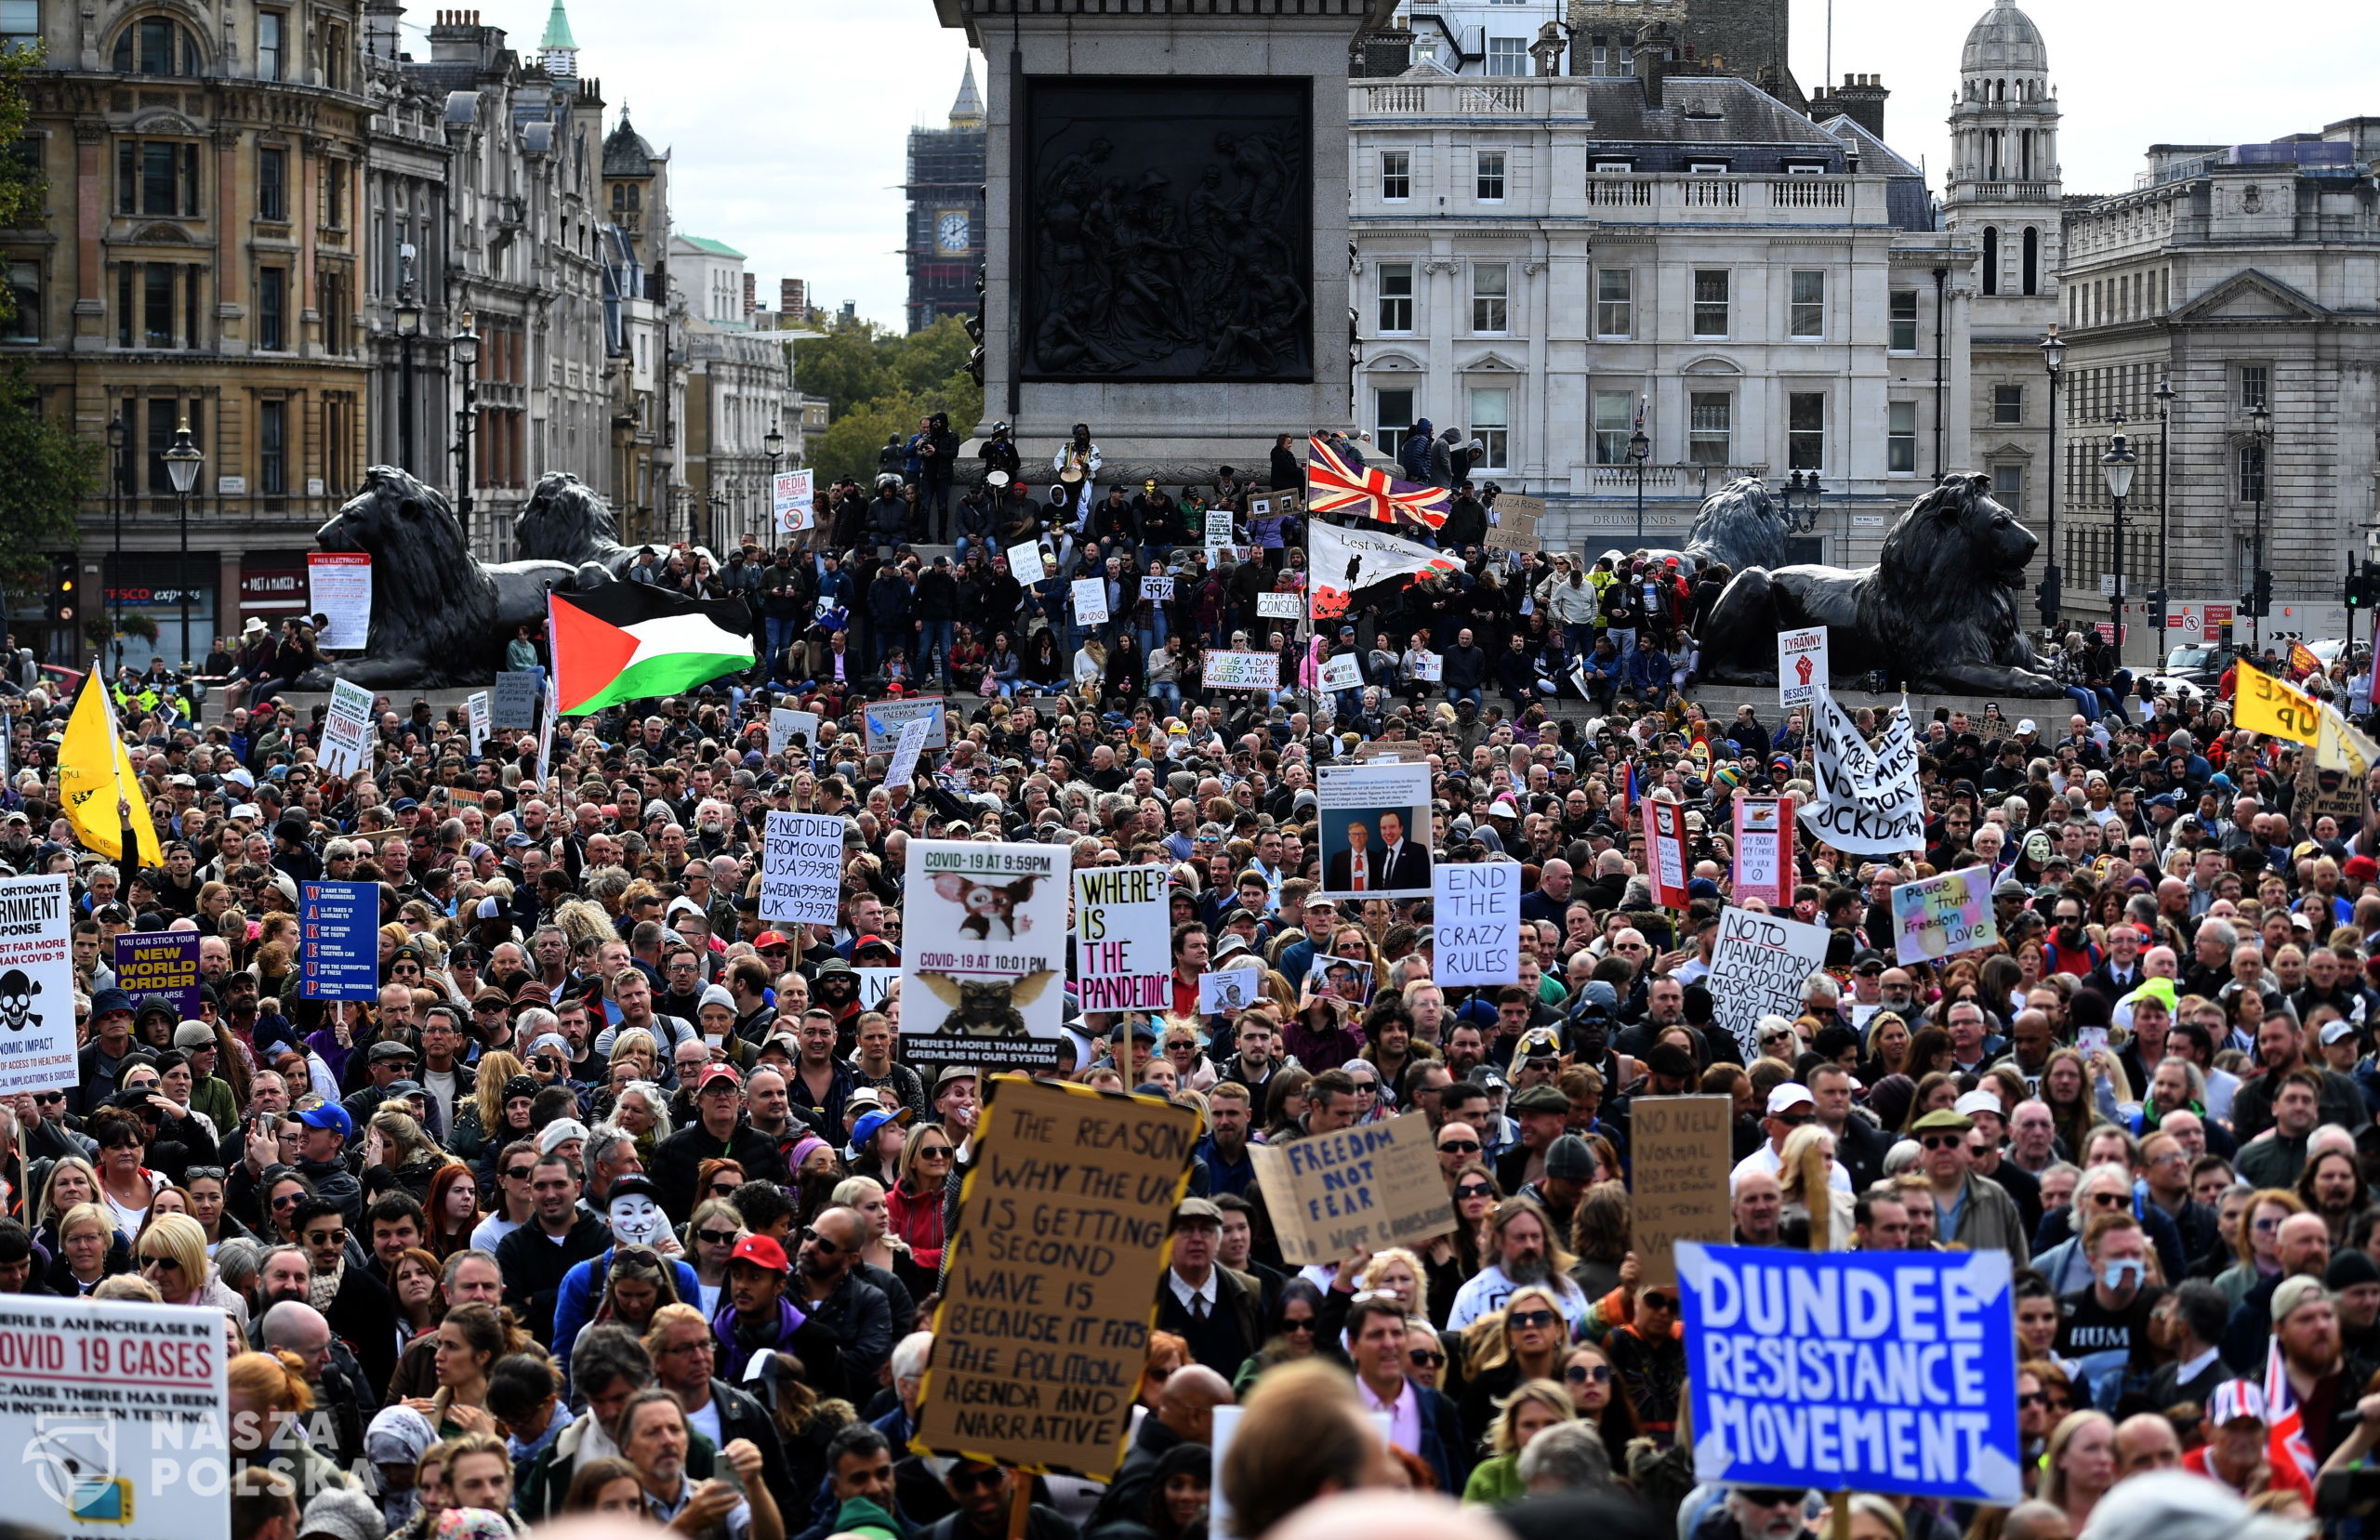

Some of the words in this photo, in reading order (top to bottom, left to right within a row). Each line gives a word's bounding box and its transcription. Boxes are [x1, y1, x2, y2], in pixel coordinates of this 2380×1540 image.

[778, 476, 807, 491] MEDIA
[777, 488, 807, 498] DISTANCING
[1496, 496, 1540, 510] WIZARDZ
[1593, 515, 1677, 525] DRUMMONDS
[1341, 534, 1370, 550] Lest
[1488, 532, 1533, 547] LIZARDZ
[250, 578, 267, 591] PRET
[272, 577, 295, 590] MANGER
[1144, 584, 1171, 598] 99%
[154, 588, 201, 602] expss
[1784, 634, 1821, 651] TYRANNY
[1214, 665, 1244, 674] KEEPS
[1250, 666, 1268, 675] THE
[1220, 656, 1240, 665] HUG
[1256, 657, 1276, 666] DAY
[1208, 674, 1240, 683] COVID
[1244, 677, 1275, 685] AWAY
[336, 684, 371, 708] QUARANTINE
[1784, 698, 1809, 706] BECOMES
[883, 710, 918, 719] FACEMASK
[1966, 715, 2010, 728] QUESTION
[329, 714, 363, 741] TYRANNY
[1967, 721, 2016, 735] EVERYTHING
[779, 818, 804, 836] NOT
[806, 819, 842, 838] DIED
[766, 838, 800, 856] FROM
[800, 842, 840, 859] COVID
[1742, 836, 1752, 845] MY
[1755, 836, 1774, 846] BODY
[1742, 847, 1752, 856] MY
[1754, 847, 1776, 856] CHOICE
[765, 858, 797, 876] USA
[985, 855, 1001, 869] AT
[1743, 860, 1753, 868] NO
[1081, 869, 1166, 905] WHERE?
[1448, 867, 1506, 890] END
[762, 882, 800, 898] SWEDEN
[1906, 881, 1952, 903] Peace
[761, 899, 786, 916] UK
[1448, 892, 1506, 916] THE
[1934, 891, 1973, 909] truth
[1725, 914, 1757, 941] NO
[1759, 921, 1787, 947] TO
[1904, 913, 1960, 934] Freedom
[136, 938, 152, 946] CAN
[152, 936, 174, 945] STICK
[176, 935, 195, 943] YOUR
[1439, 924, 1507, 948] CRAZY
[13, 941, 33, 952] FAR
[35, 939, 66, 950] MORE
[134, 947, 181, 961] NEW
[20, 952, 65, 965] COVID-19
[976, 954, 990, 968] AT
[995, 954, 1025, 969] 10:01
[1029, 956, 1046, 970] PM
[1082, 941, 1132, 974] THE
[1447, 948, 1508, 974] RULES
[1719, 939, 1820, 980] MANDATORY
[119, 960, 197, 976] WORLD
[120, 974, 195, 991] ORDER
[25, 1037, 54, 1052] IMPACT
[906, 1038, 953, 1050] THERE'S
[955, 1040, 992, 1051] MORE
[994, 1041, 1027, 1052] THAN
[1028, 1042, 1057, 1053] JUST
[8, 1060, 29, 1070] ACCESS
[30, 1059, 37, 1068] TO
[37, 1054, 73, 1067] HEALTHCARE
[906, 1049, 967, 1060] GREMLINS
[968, 1051, 980, 1060] IN
[982, 1051, 1007, 1062] OUR
[1009, 1052, 1058, 1064] SYSTEM
[10, 1073, 48, 1086] IMPLICATIONS
[54, 1069, 76, 1081] SUICIDE
[1635, 1109, 1668, 1135] NO
[1674, 1111, 1720, 1133] NEW
[1012, 1108, 1058, 1143] THE
[1075, 1116, 1192, 1162] REASON
[1288, 1127, 1395, 1177] FREEDOM
[1637, 1142, 1712, 1162] NORMAL
[991, 1153, 1071, 1193] WHY
[1079, 1165, 1130, 1199] THE
[1136, 1176, 1177, 1206] UK
[1321, 1161, 1374, 1191] NOT
[1637, 1166, 1659, 1183] NO
[1662, 1165, 1709, 1179] MORE
[1307, 1187, 1374, 1222] FEAR
[1637, 1205, 1662, 1221] NO
[981, 1197, 1016, 1231] IS
[1033, 1205, 1166, 1250] GETTING
[955, 1230, 973, 1258] A
[987, 1232, 1115, 1278] SECOND
[963, 1268, 1046, 1306] WAVE
[1064, 1283, 1093, 1311] IS
[1700, 1260, 1985, 1342] DUNDEE
[40, 1316, 56, 1329] IS
[61, 1316, 87, 1331] AN
[93, 1318, 182, 1336] INCREASE
[184, 1323, 210, 1337] IN
[948, 1304, 1068, 1346] BECAUSE
[77, 1336, 110, 1374] 19
[119, 1339, 213, 1379] CASES
[946, 1338, 1005, 1374] THE
[1703, 1333, 1987, 1406] RESISTANCE
[61, 1387, 124, 1402] THERE
[126, 1390, 168, 1406] HAS
[171, 1393, 218, 1409] BEEN
[943, 1375, 1043, 1411] AGENDA
[1055, 1387, 1119, 1416] AND
[953, 1410, 1114, 1447] NARRATIVE
[1708, 1393, 1990, 1484] MOVEMENT
